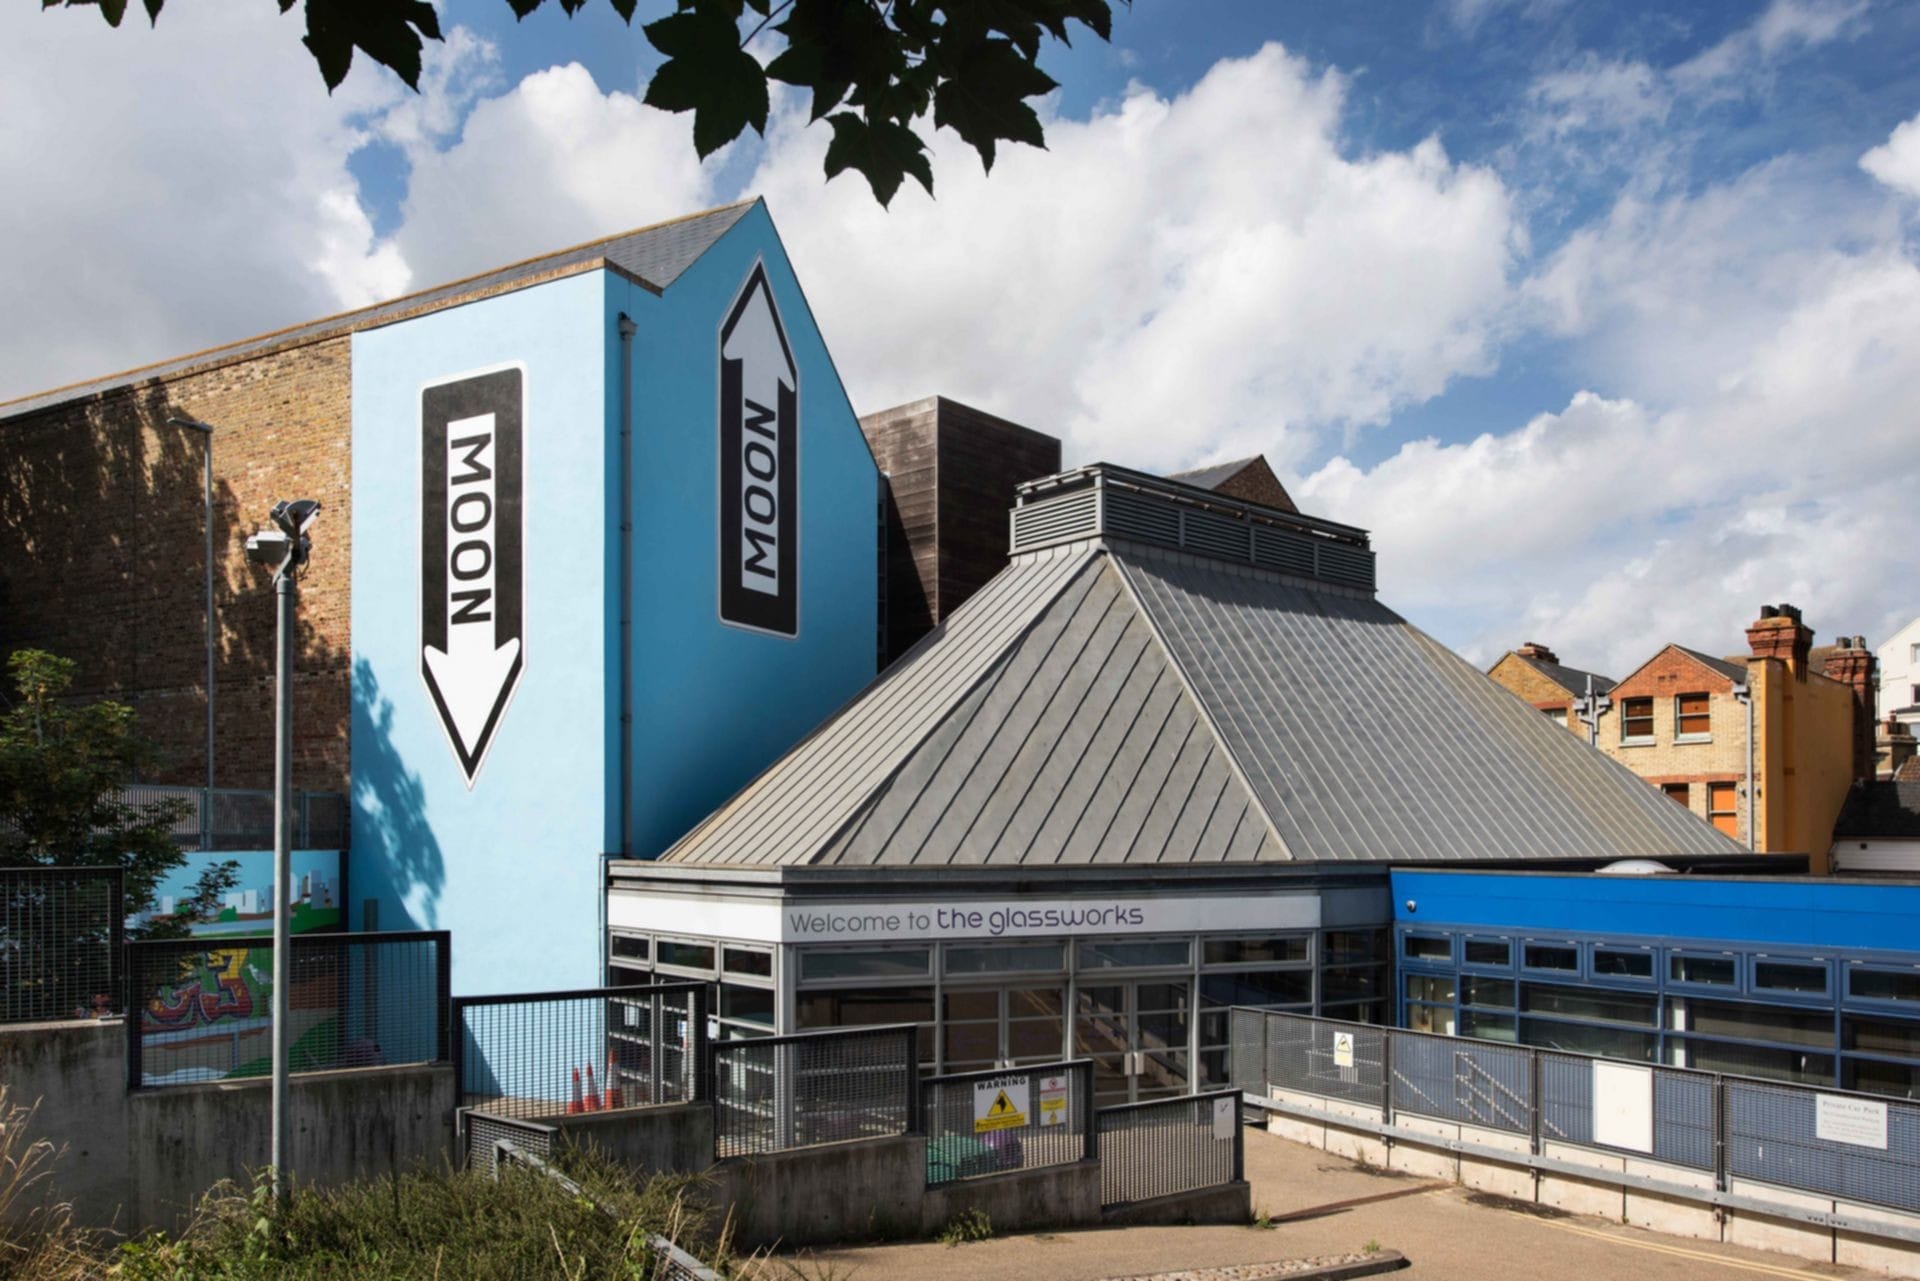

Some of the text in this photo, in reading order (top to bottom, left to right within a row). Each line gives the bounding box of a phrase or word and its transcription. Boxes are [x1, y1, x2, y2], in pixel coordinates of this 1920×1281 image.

[450, 432, 492, 625] MOON
[744, 398, 778, 579] MOON
[790, 912, 901, 933] Welcome
[907, 912, 931, 931] to
[977, 1077, 1026, 1090] WARNING
